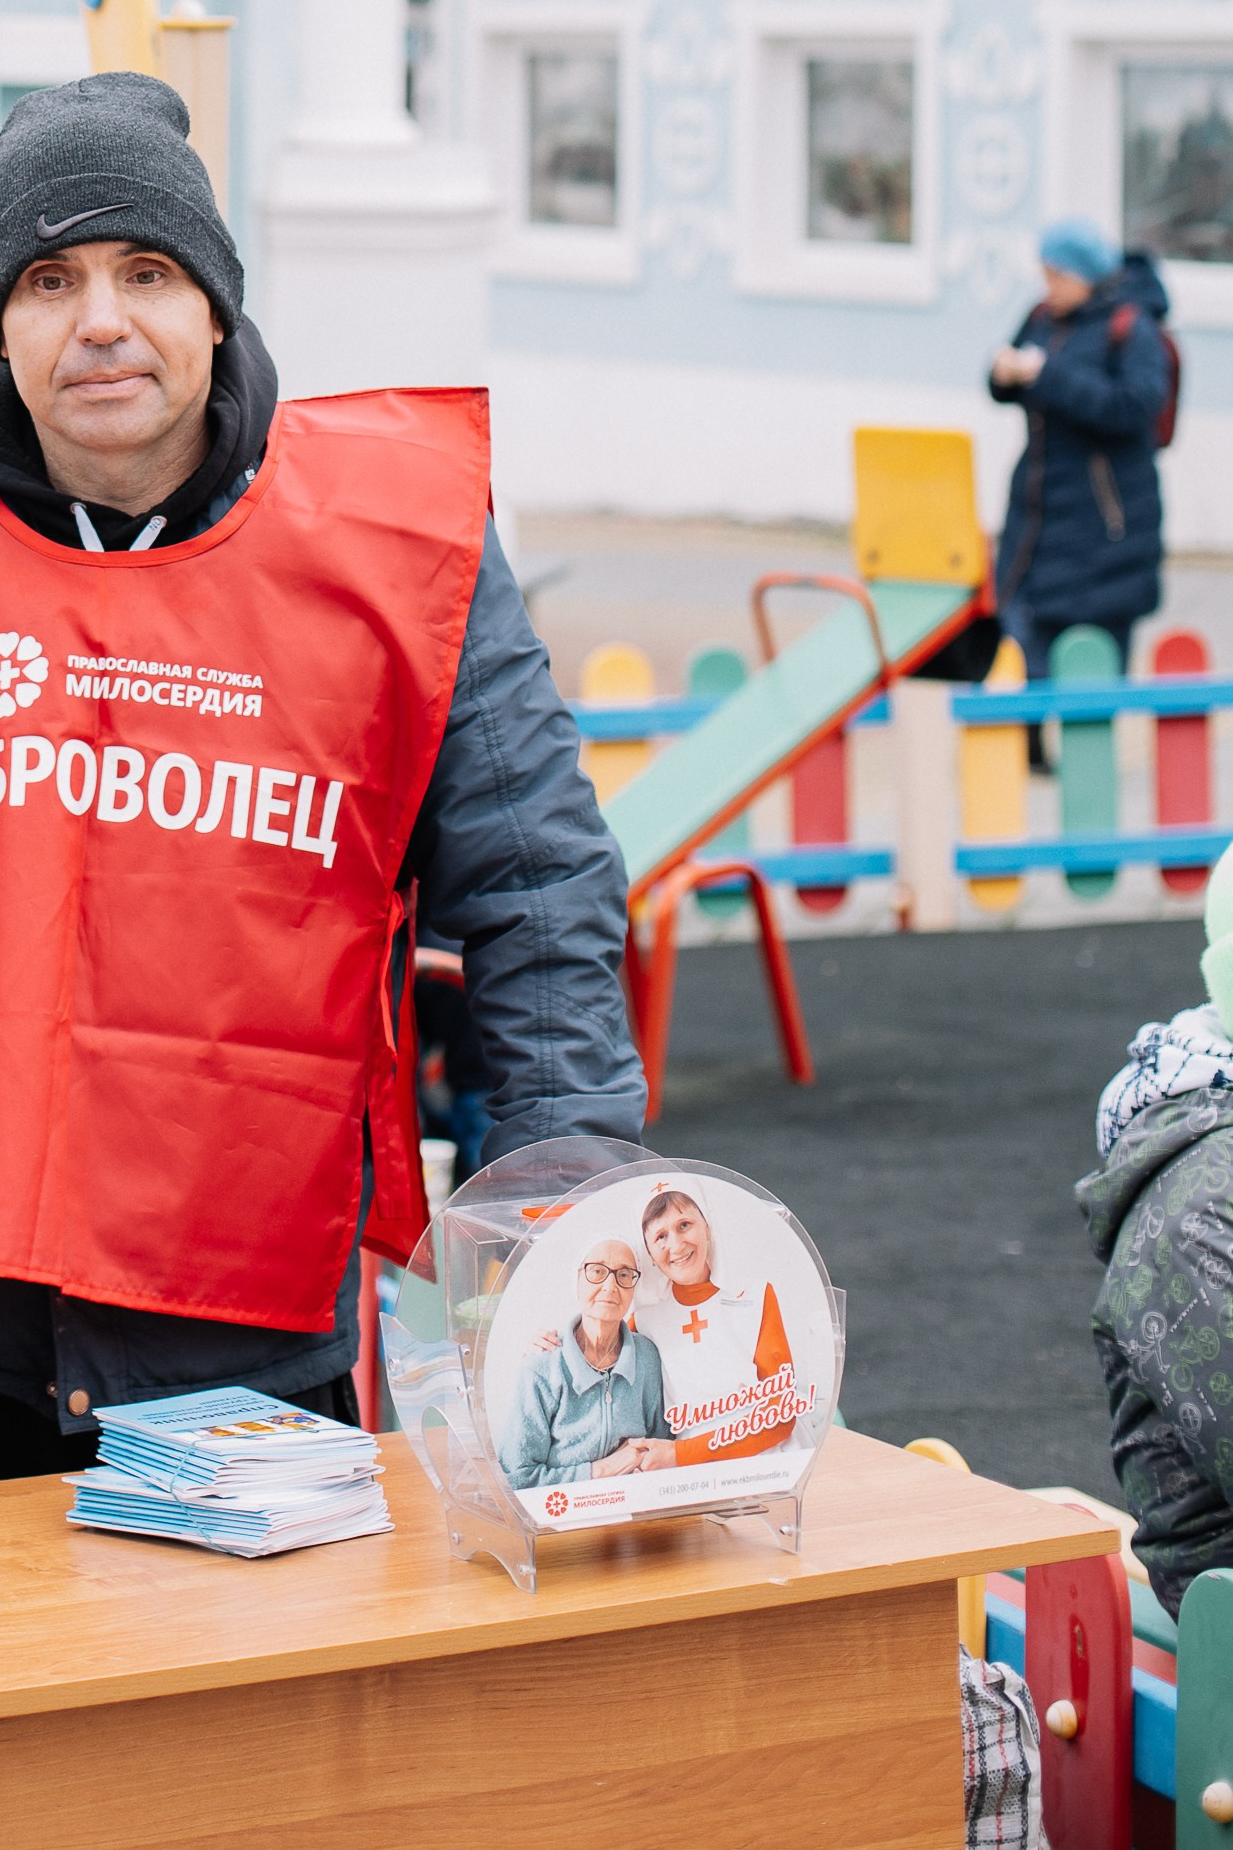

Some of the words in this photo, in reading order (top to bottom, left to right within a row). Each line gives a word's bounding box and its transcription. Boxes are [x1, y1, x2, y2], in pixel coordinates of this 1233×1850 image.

[67, 654, 193, 678] ПРАВОСЛАВНАЯ
[196, 667, 264, 689] СЛУЖБА
[65, 674, 263, 718] МИЛОСЕРДИЯ
[148, 1404, 279, 1425] Справочник
[666, 1364, 794, 1431] Умножай
[710, 1384, 815, 1447] любовь!
[574, 1495, 626, 1509] МИЛОСЕРДИЯ
